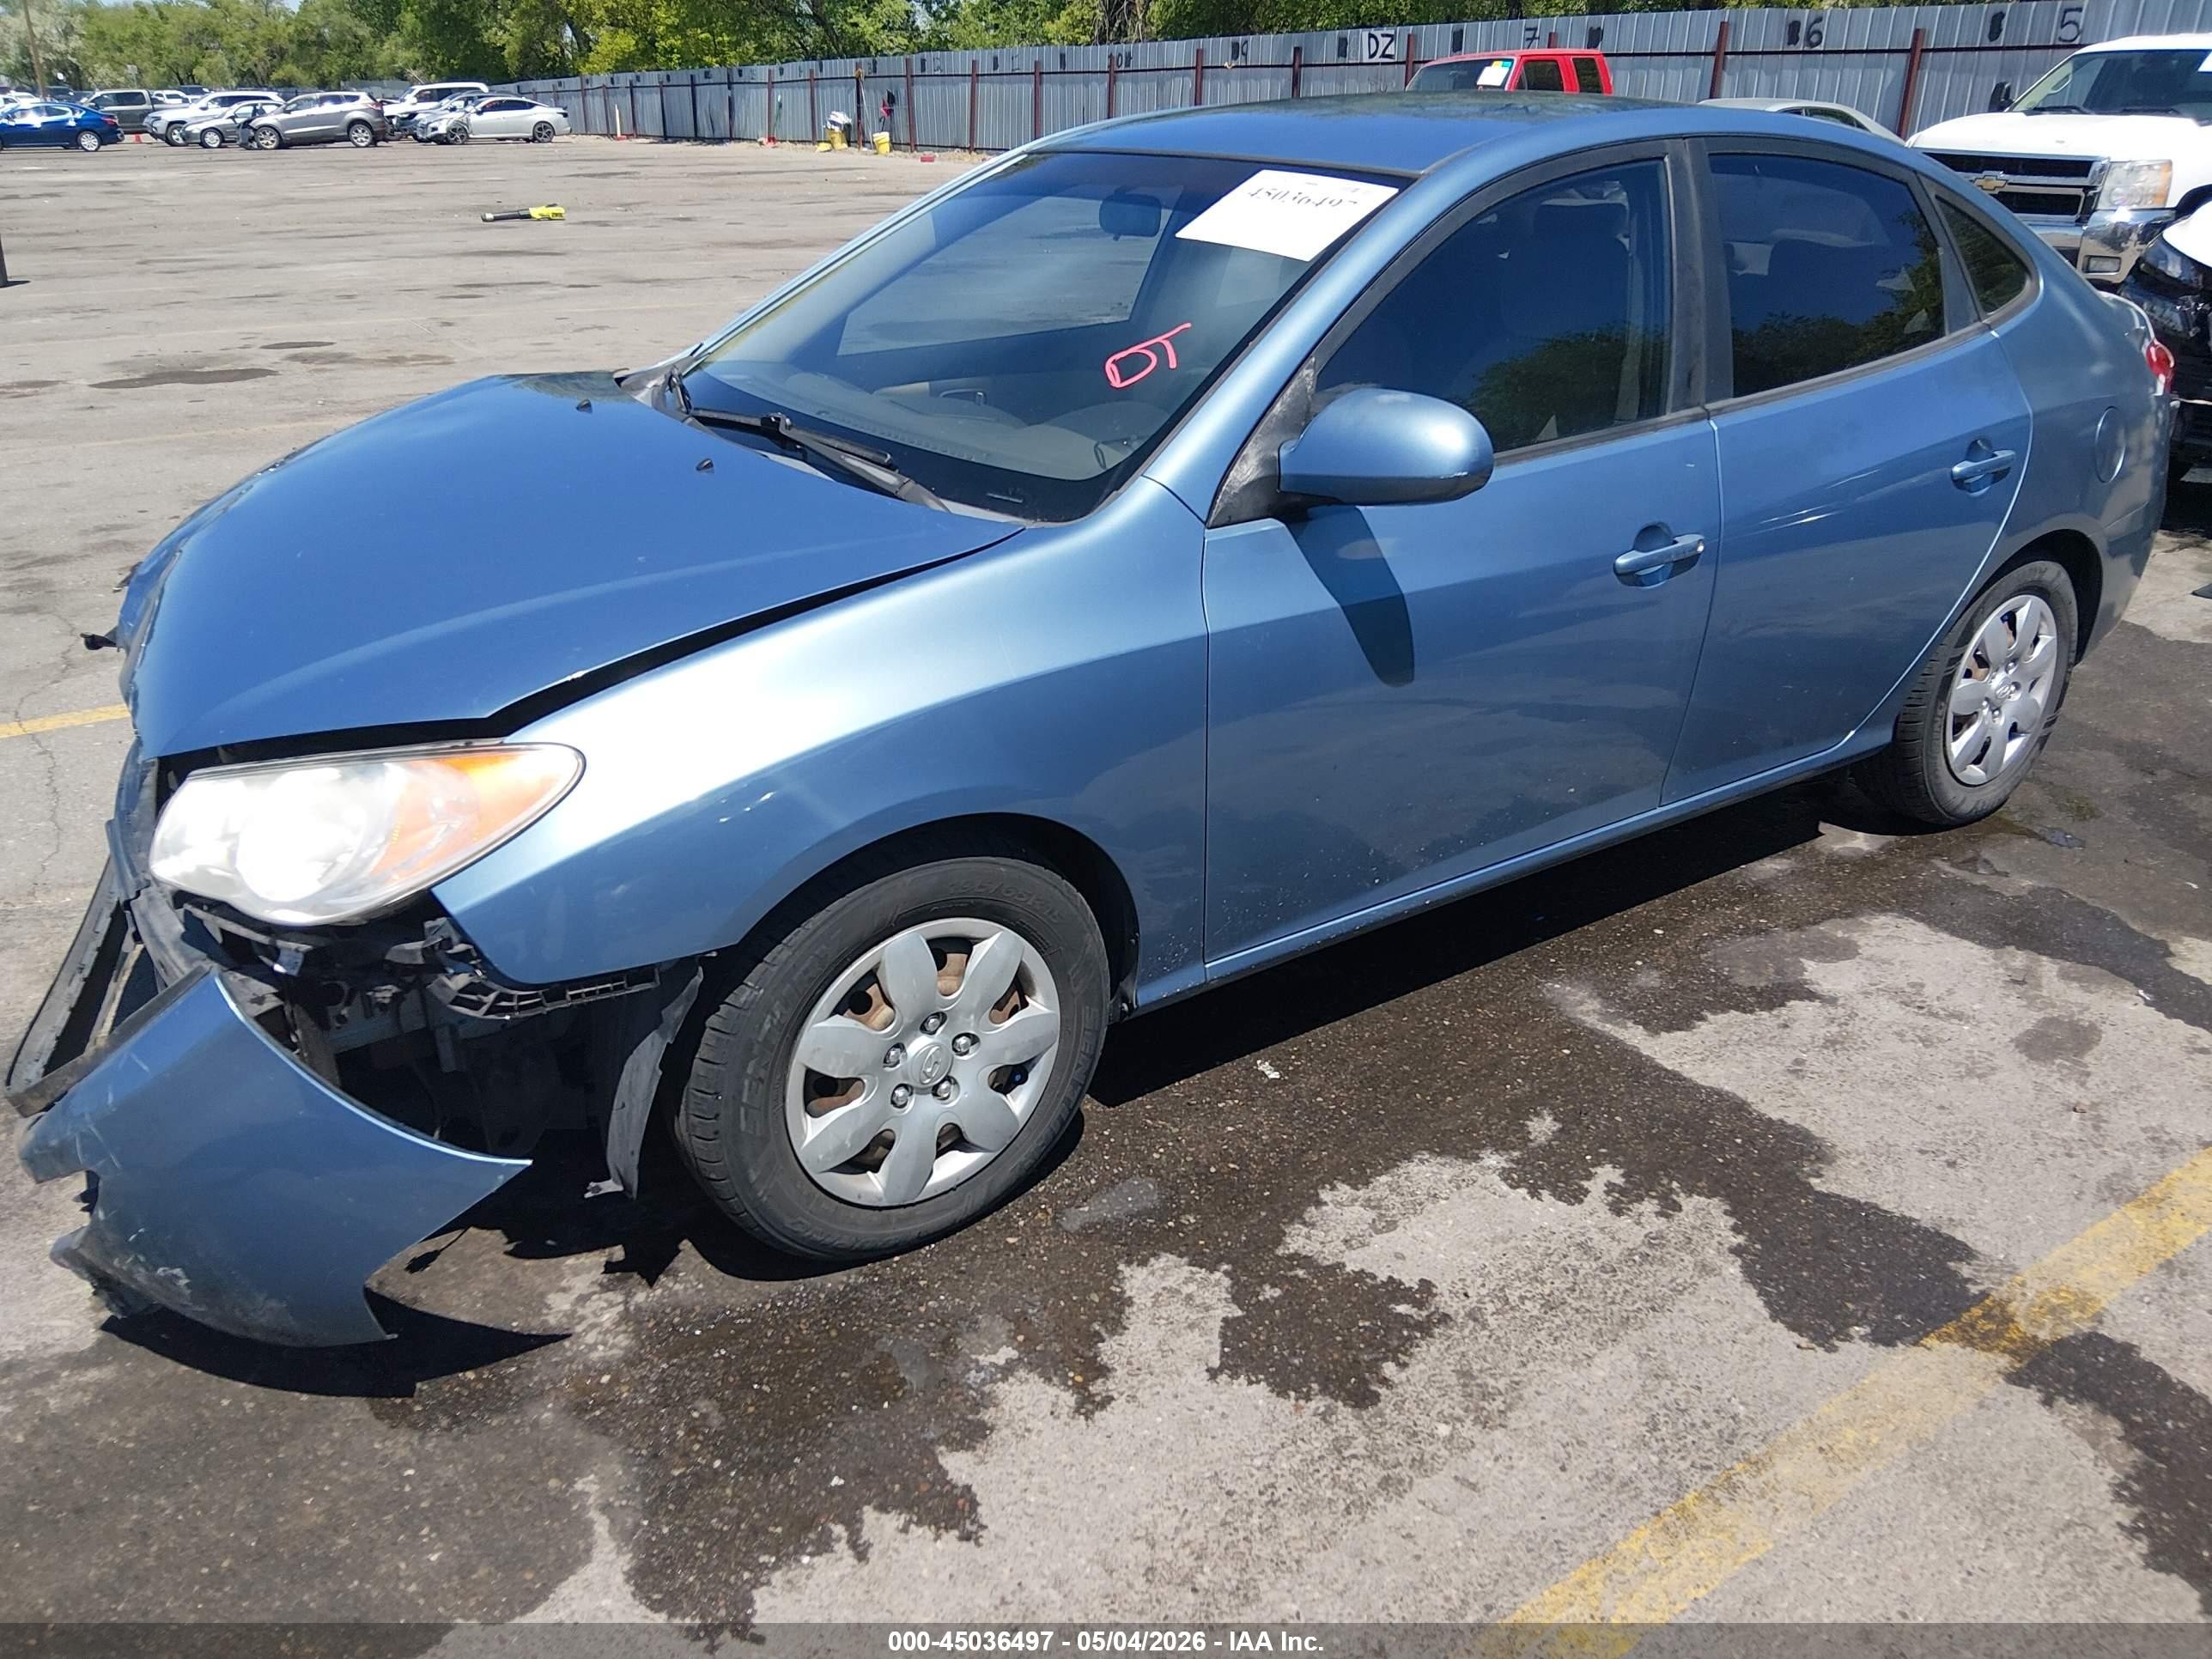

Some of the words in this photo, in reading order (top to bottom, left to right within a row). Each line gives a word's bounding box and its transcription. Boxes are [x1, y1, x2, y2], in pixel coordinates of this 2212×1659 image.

[1525, 27, 1540, 49] 7
[1804, 16, 1825, 49] 6
[2060, 8, 2084, 43] 5
[1367, 33, 1395, 60] DZ
